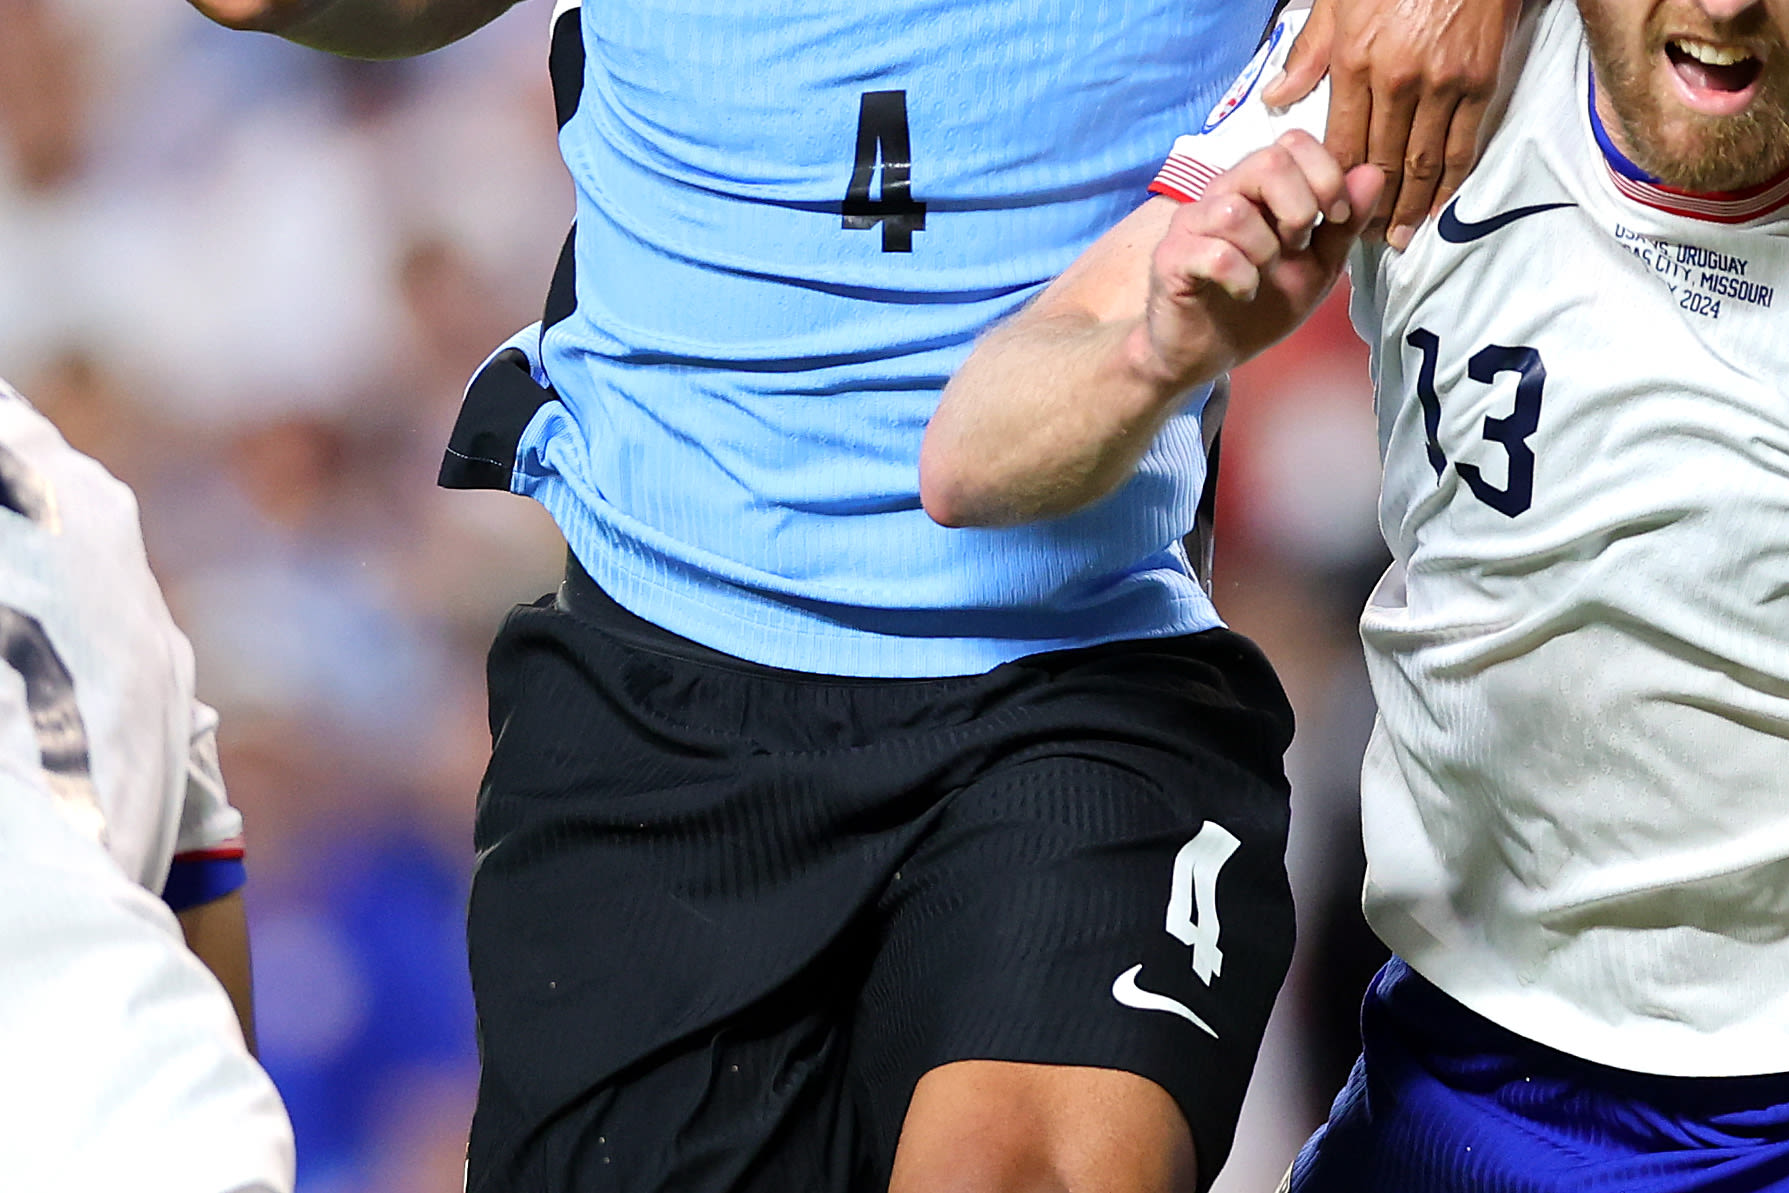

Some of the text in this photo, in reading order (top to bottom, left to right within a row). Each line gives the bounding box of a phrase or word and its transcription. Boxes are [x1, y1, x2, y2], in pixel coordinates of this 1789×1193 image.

[841, 89, 927, 253] 4
[1675, 242, 1748, 276] URUGUAY
[1679, 289, 1721, 319] 2024
[1700, 271, 1774, 308] MISSOURI
[1406, 327, 1548, 519] 13
[1165, 820, 1242, 988] 4
